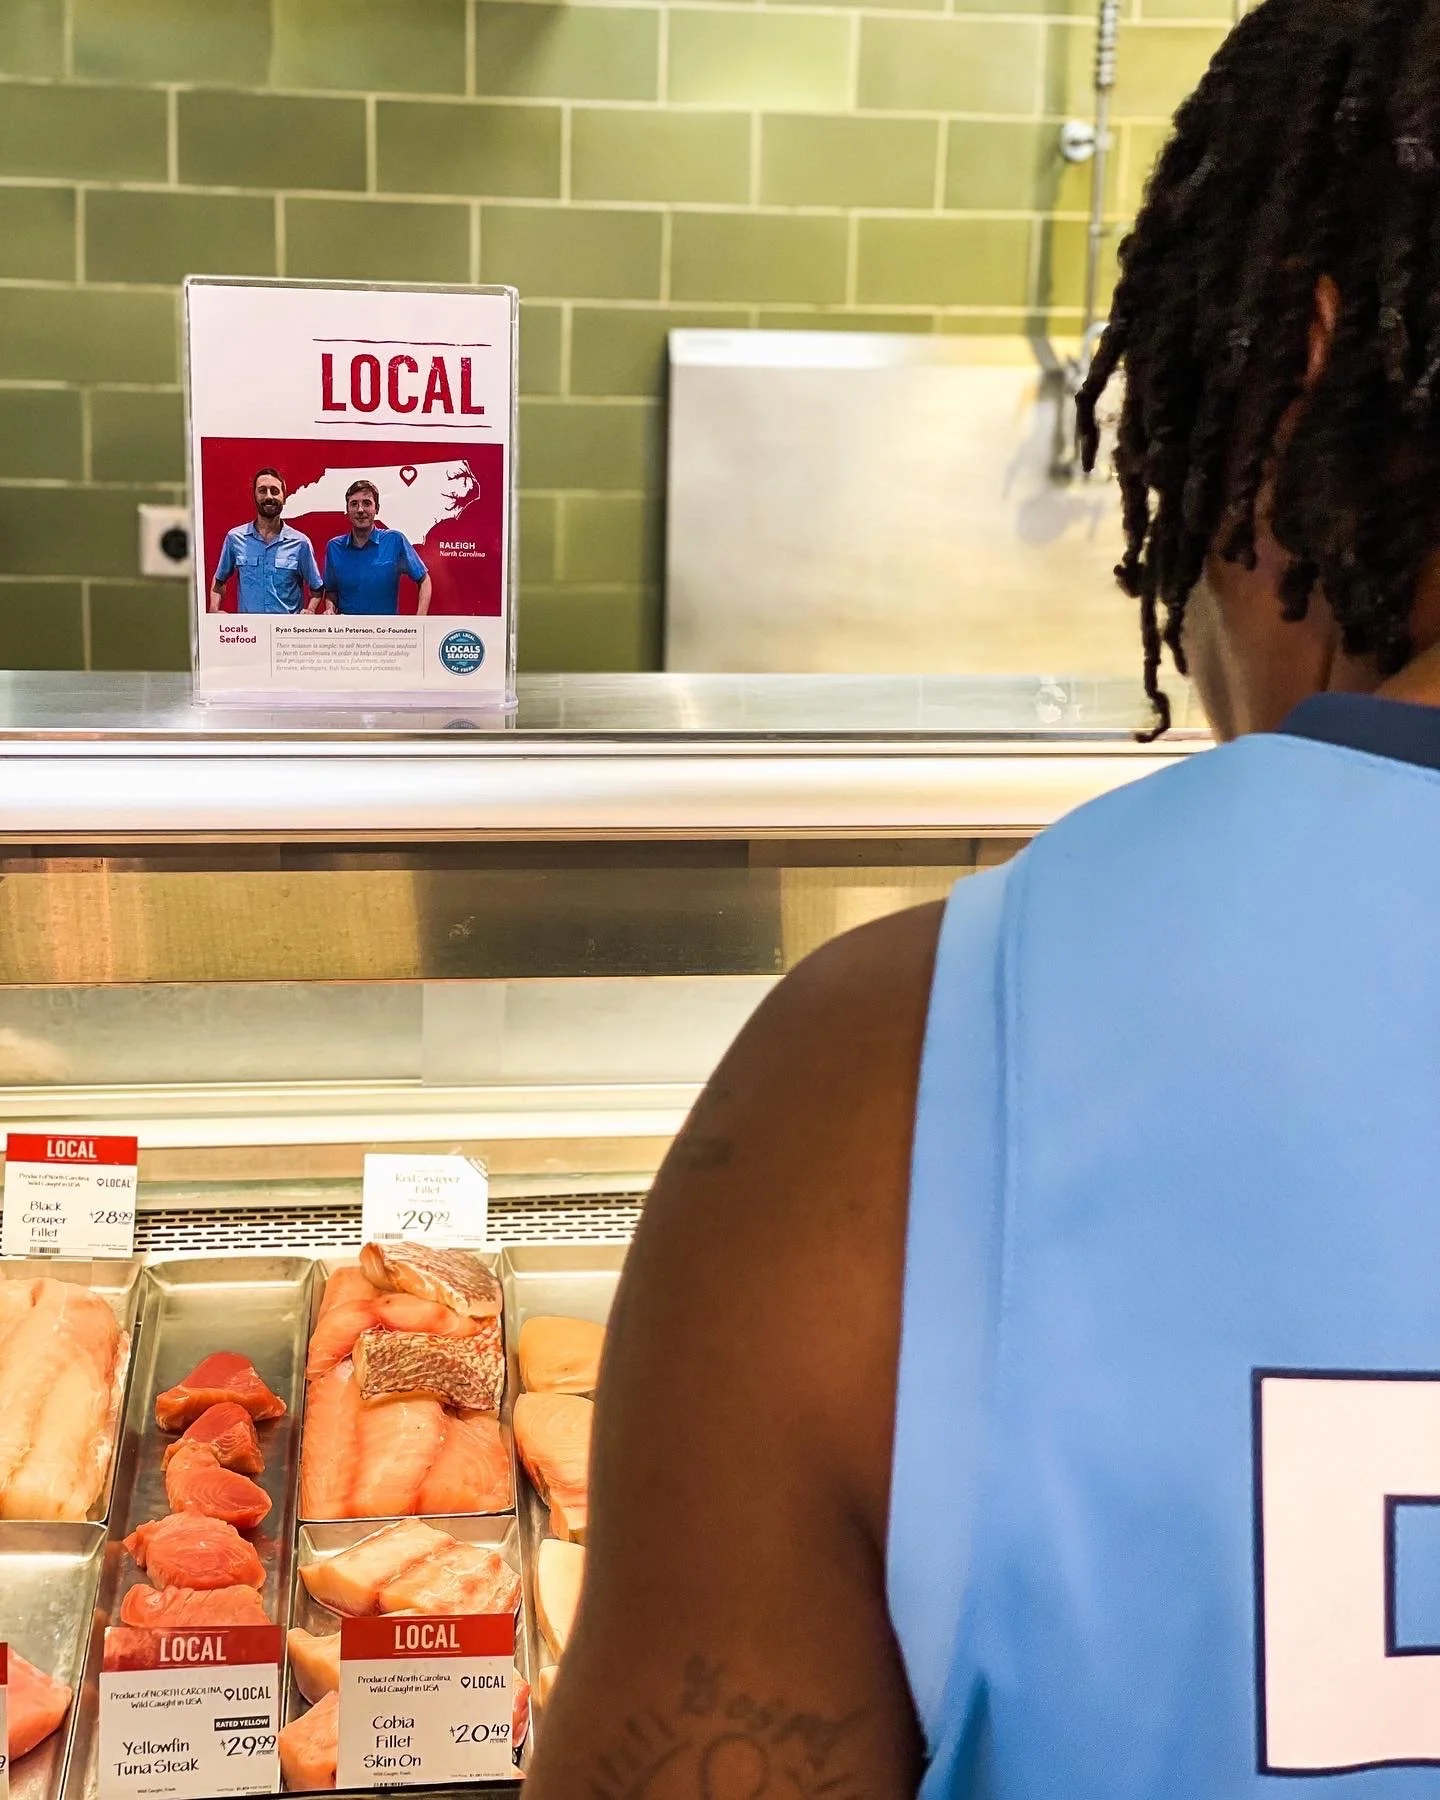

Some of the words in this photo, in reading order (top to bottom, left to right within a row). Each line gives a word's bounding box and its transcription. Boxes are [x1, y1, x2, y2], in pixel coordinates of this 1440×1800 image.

[322, 353, 485, 414] LOCAL
[440, 541, 475, 549] RALEIGH
[219, 625, 248, 633] Locals
[219, 635, 257, 644] Seafood
[445, 645, 481, 653] LOCALS
[46, 1139, 97, 1159] LOCAL
[105, 1178, 131, 1188] LOCAL
[30, 1201, 62, 1211] Black
[22, 1213, 66, 1225] Grouper
[31, 1227, 57, 1237] Fillet
[395, 1623, 460, 1650] LOCAL
[159, 1636, 227, 1662] LOCAL
[419, 1674, 451, 1682] Carolina
[472, 1675, 506, 1689] LOCAL
[110, 1692, 140, 1700] Product
[150, 1688, 180, 1698] NORTH
[181, 1686, 222, 1696] CAROLINA
[236, 1686, 271, 1700] LOCAL
[369, 1685, 386, 1693] Wild
[387, 1685, 414, 1694] Caught
[423, 1684, 439, 1692] USA
[149, 1699, 175, 1708] Caught
[185, 1697, 202, 1706] USA
[240, 1718, 268, 1727] YELLOW
[372, 1715, 415, 1730] Cobia
[122, 1737, 190, 1756] Yellowfin
[376, 1735, 413, 1749] Fillet
[113, 1761, 151, 1777] Tuna
[154, 1758, 199, 1774] Steak
[363, 1754, 396, 1769] Skin
[399, 1753, 421, 1767] On
